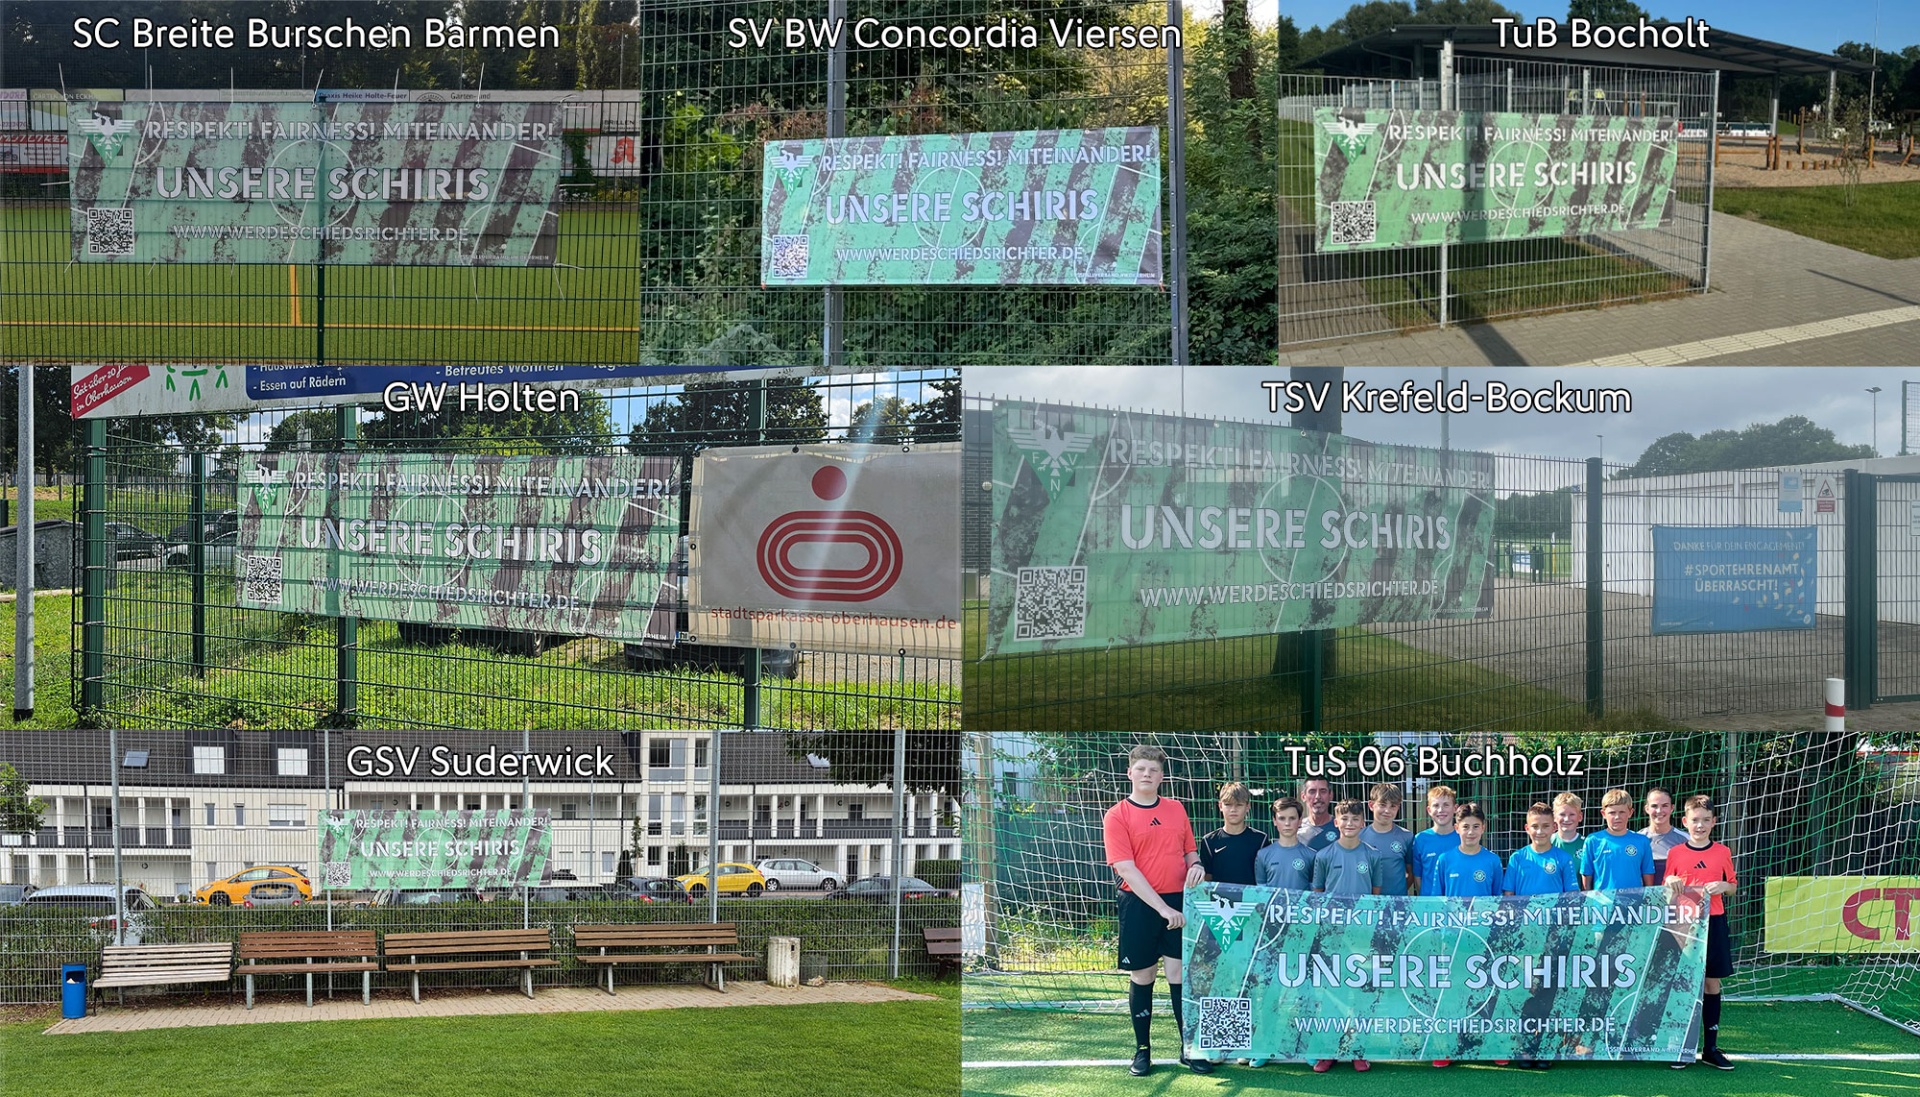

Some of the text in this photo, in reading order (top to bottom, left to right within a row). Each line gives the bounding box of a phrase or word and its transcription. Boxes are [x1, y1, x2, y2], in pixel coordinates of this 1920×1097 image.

[365, 91, 407, 99] Holte-Feuer
[149, 121, 553, 141] RESPEKT! FAIRNESS! MITEINANDER!
[1389, 124, 1674, 143] RESPEKT! FAIRNESS! MITEINANDER!
[822, 145, 1152, 172] RESPEKT! FAIRNESS! MITEINANDER!
[157, 167, 489, 200] UNSERE SCHIRIS
[1397, 161, 1637, 190] UNSERE SCHIRIS
[826, 189, 1098, 224] UNSERE SCHIRIS
[1411, 203, 1625, 224] WWW.WERDESCHIEDSRICHTER.DE
[173, 225, 469, 242] WWW.WERDESCHIEDSRICHTER.DE
[836, 245, 1084, 262] WWW.WERDESCHIEDSRICHTER.DE
[445, 365, 503, 377] Betreutes
[260, 375, 346, 391] Essen auf Rädern
[1110, 438, 1242, 471] RESPEKT!
[1249, 447, 1363, 481] FAIRNESS!
[296, 471, 671, 499] RESPEKT! FAIRNESS! MITEINANDER!
[1121, 504, 1451, 550] UNSERE SCHIRIS
[301, 517, 602, 566] UNSERE SCHIRIS
[1673, 541, 1704, 551] DANKE
[1684, 563, 1799, 576] #SPORTEHRENAMT
[313, 576, 579, 611] WWW.WERDESCHIEDSRICHTER.DE
[1140, 578, 1439, 608] WWW.WERDESCHIEDSRICHTER.DE
[1695, 578, 1778, 592] ÜBERRASCHT!
[711, 606, 957, 630] stadtsparkasse-oberhausen.de
[356, 816, 548, 829] RESPEKT! FAIRNESS! MITEINANDER!
[361, 839, 520, 857] UNSERE SCHIRIS
[1270, 904, 1701, 926] RESPEKT! FAIRNESS! MITEINANDER!
[1278, 953, 1637, 989] UNSERE SCHIRIS
[1294, 1016, 1616, 1034] WWW.WERDESCHIEDSRICHTER.DE
